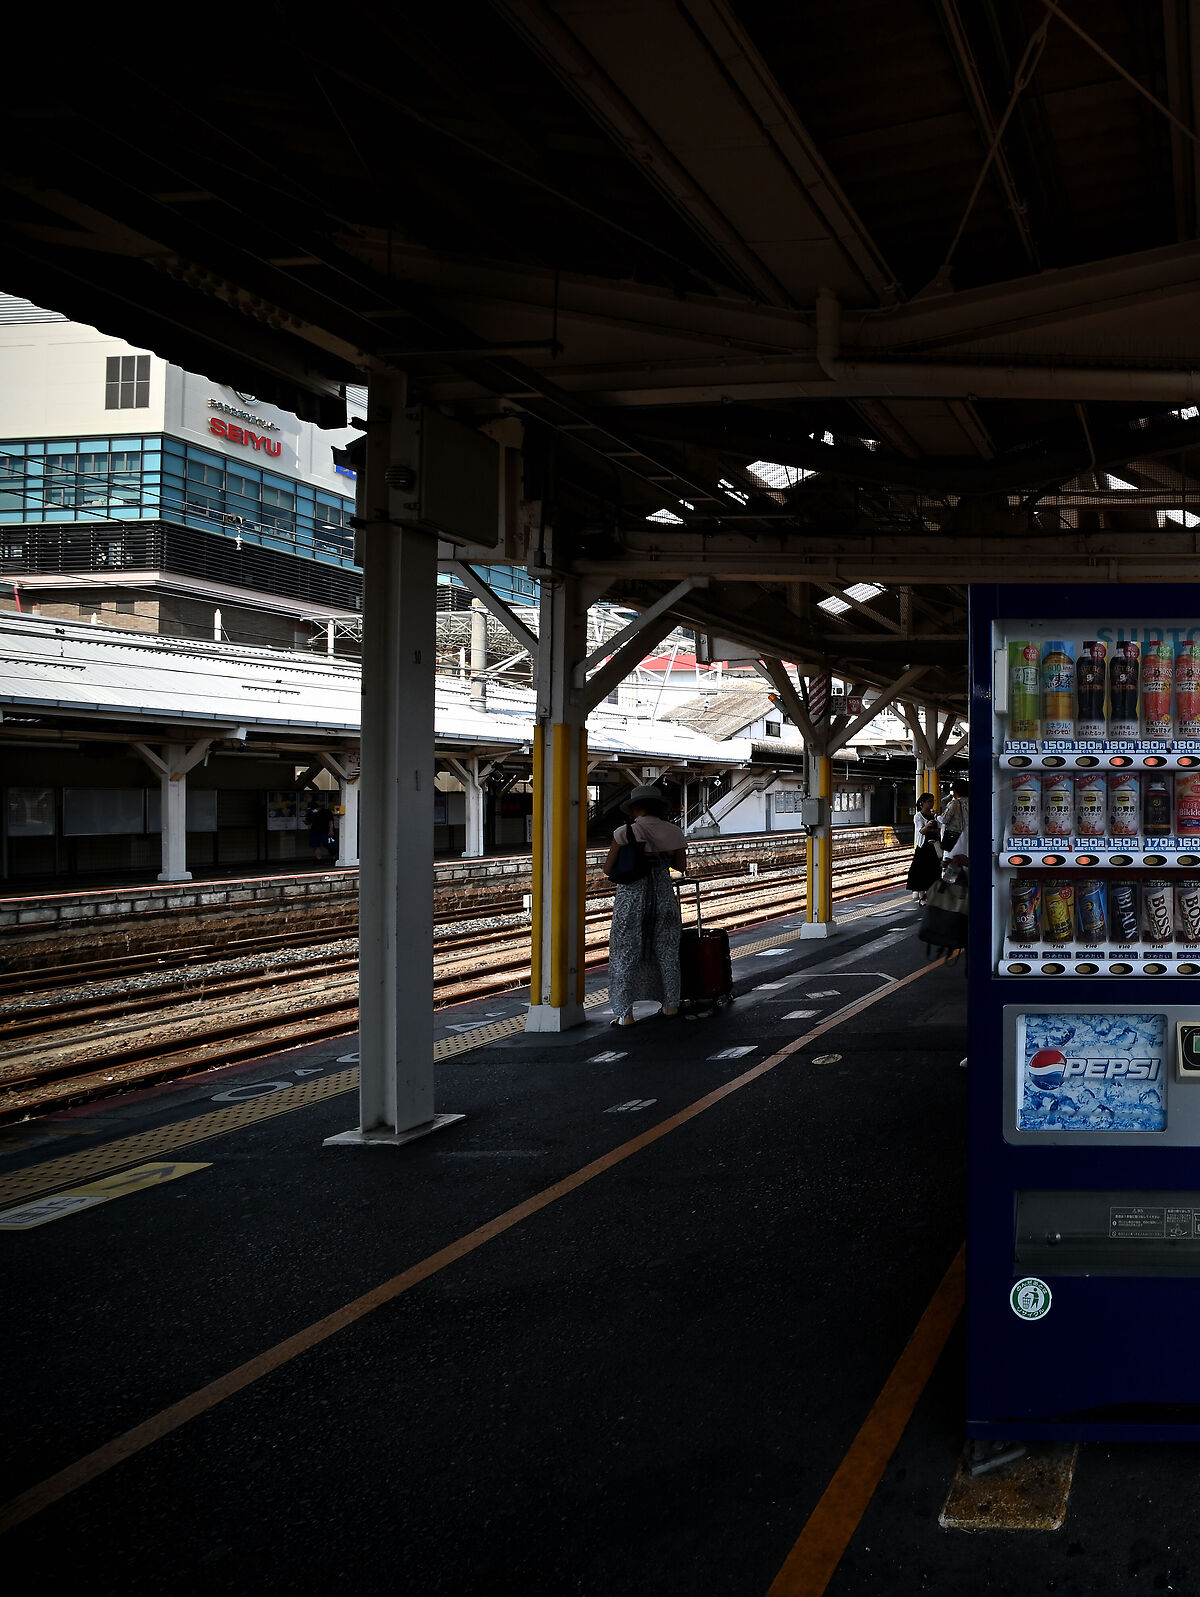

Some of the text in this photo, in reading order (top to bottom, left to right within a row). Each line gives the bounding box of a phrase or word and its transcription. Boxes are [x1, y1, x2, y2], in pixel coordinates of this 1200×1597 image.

[208, 417, 281, 457] SEIYU
[1007, 741, 1036, 750] 160円
[1044, 741, 1072, 750] 150円
[1073, 741, 1102, 750] 180円
[1105, 741, 1134, 750] 180円
[1137, 741, 1165, 750] 180円
[1172, 741, 1200, 750] 180円
[646, 769, 652, 777] 1
[1009, 838, 1038, 846] 150円
[1040, 838, 1068, 846] 150円
[1076, 838, 1104, 846] 150円
[1109, 838, 1137, 846] 150円
[1147, 838, 1175, 846] 170円
[1118, 892, 1138, 939] BLACK
[1152, 895, 1170, 938] BOSS
[1061, 1058, 1161, 1081] PEPSI
